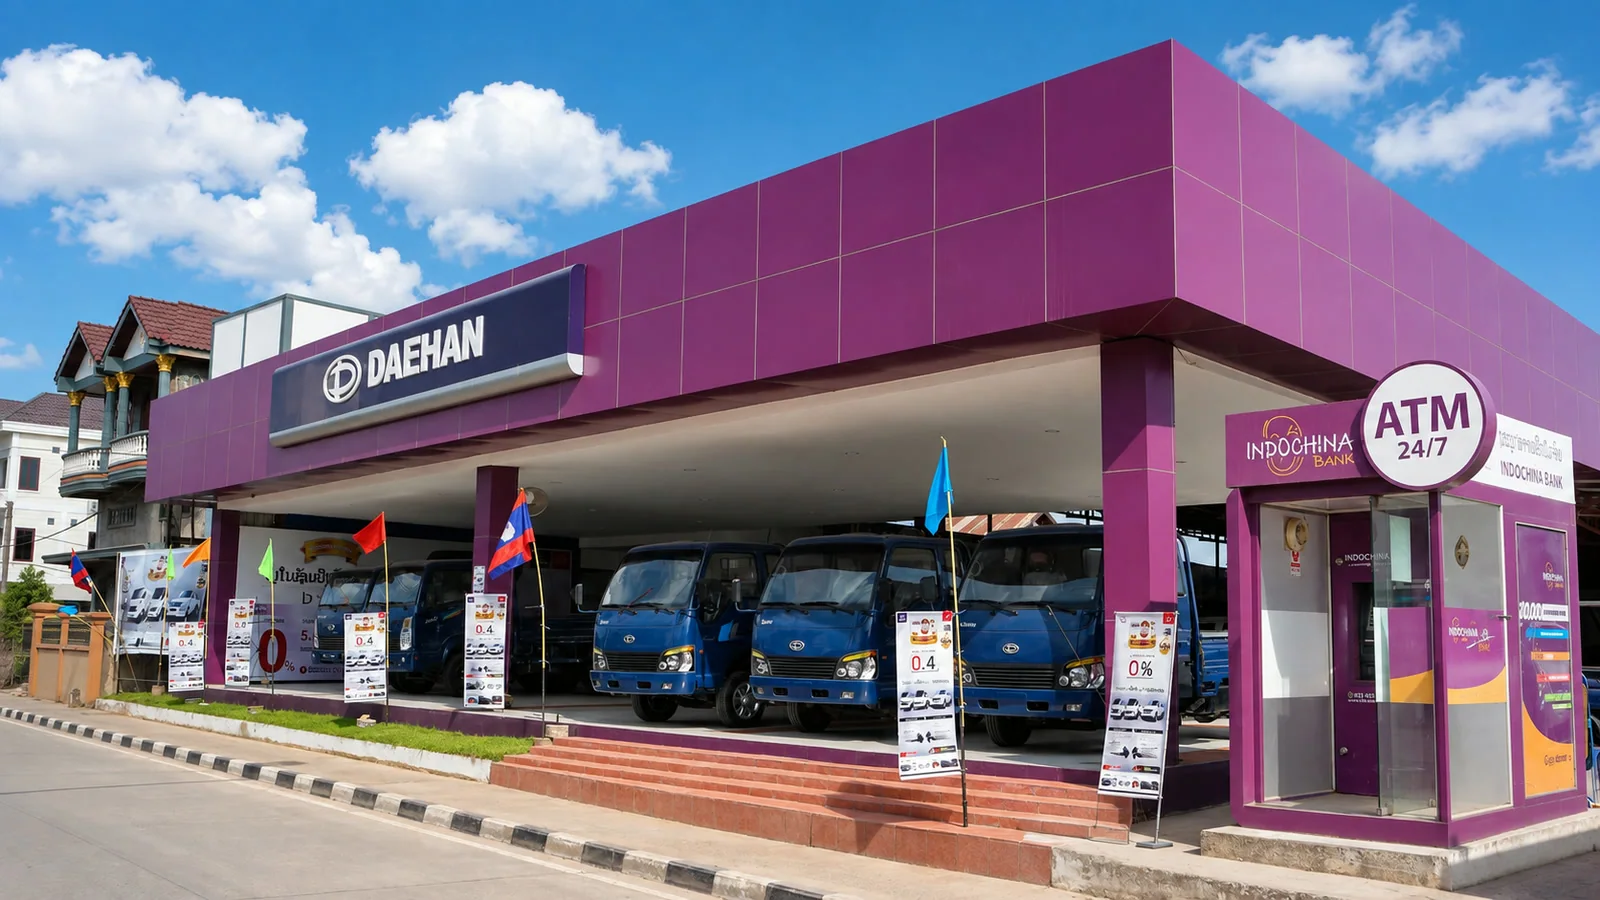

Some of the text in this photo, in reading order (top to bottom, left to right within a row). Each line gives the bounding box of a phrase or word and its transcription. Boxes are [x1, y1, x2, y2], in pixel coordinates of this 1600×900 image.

[367, 315, 485, 388] DAEHAN
[1374, 392, 1471, 439] ATM
[1246, 432, 1354, 460] INDOCHINA
[1313, 452, 1355, 468] BANK
[1397, 437, 1449, 461] 24/7
[1500, 460, 1564, 490] INDOCHINA BANK
